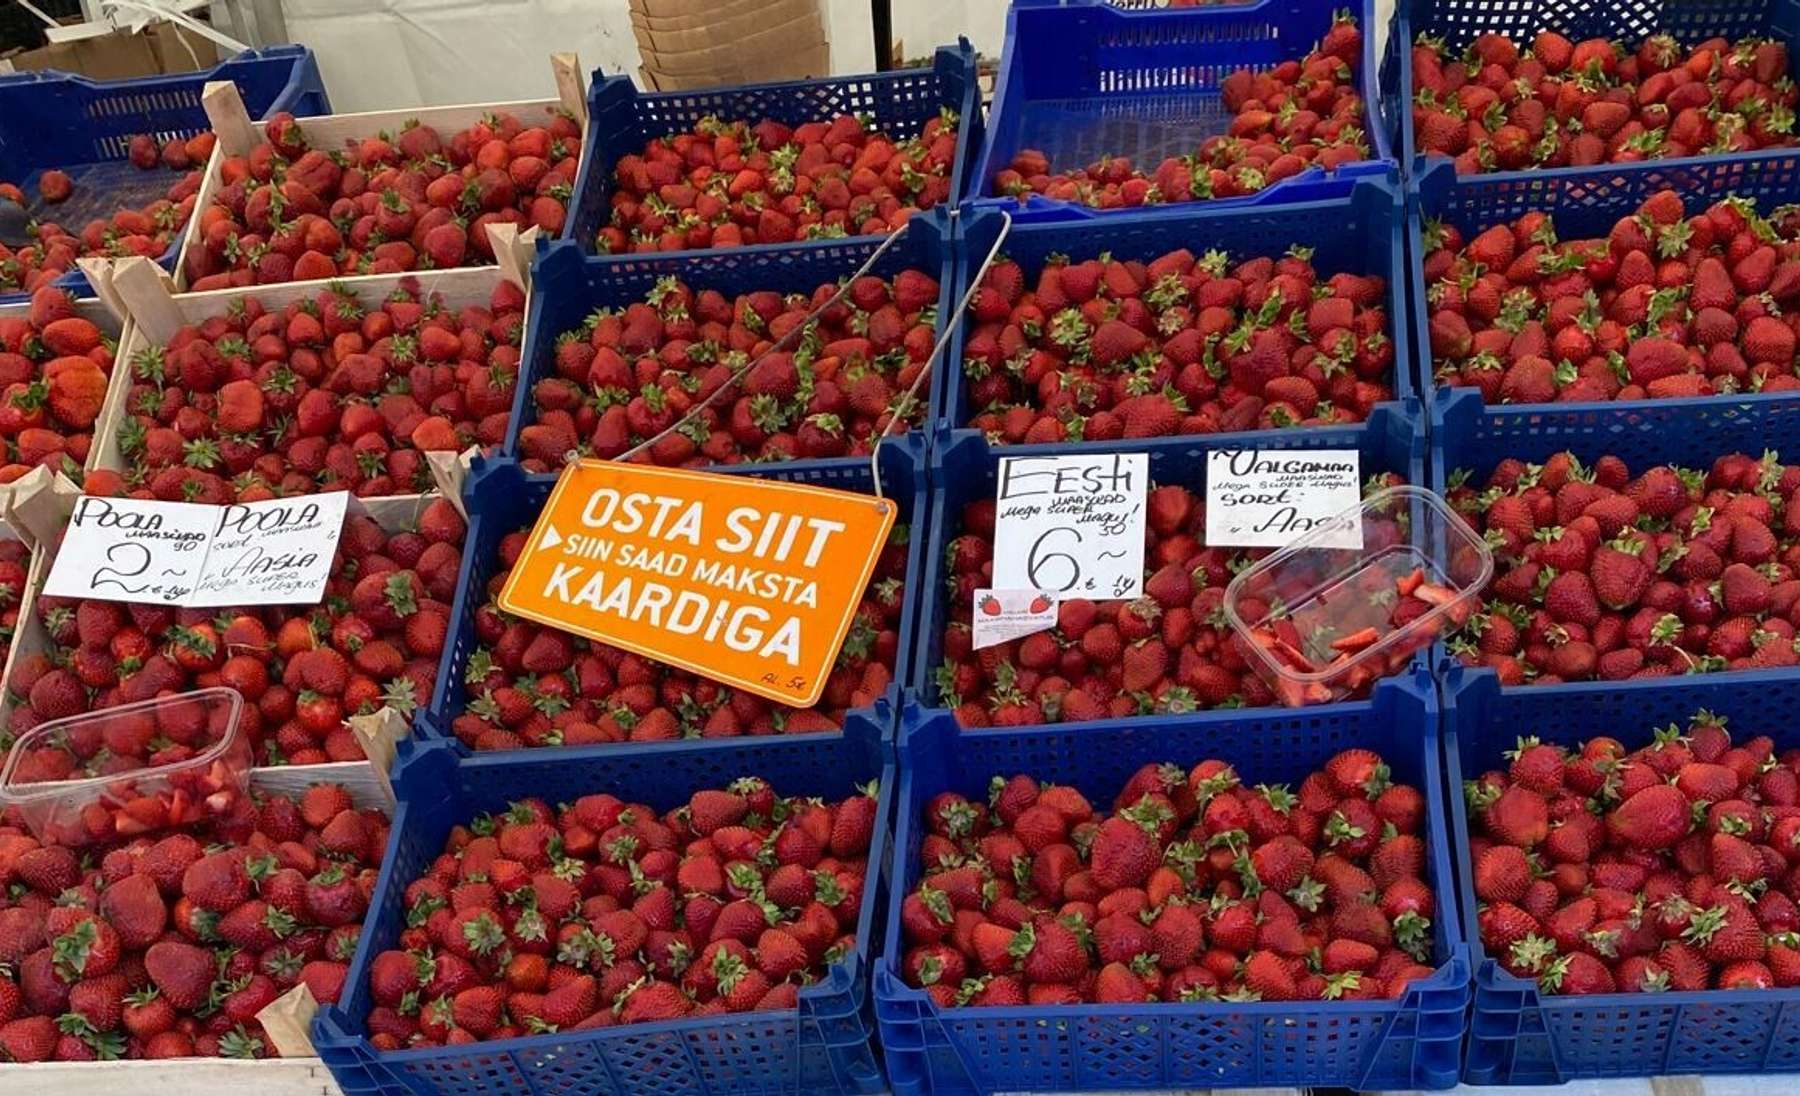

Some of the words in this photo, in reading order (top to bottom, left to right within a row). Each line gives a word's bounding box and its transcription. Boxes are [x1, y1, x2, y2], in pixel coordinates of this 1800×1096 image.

[74, 498, 162, 530] POOLA
[215, 503, 320, 538] POOLA
[581, 488, 704, 546] OSTA
[716, 507, 846, 569] SIIT
[562, 533, 615, 562] SIIN
[616, 546, 687, 578] SAAD
[691, 558, 818, 609] MAKSTA
[542, 561, 802, 666] KAARDIGA
